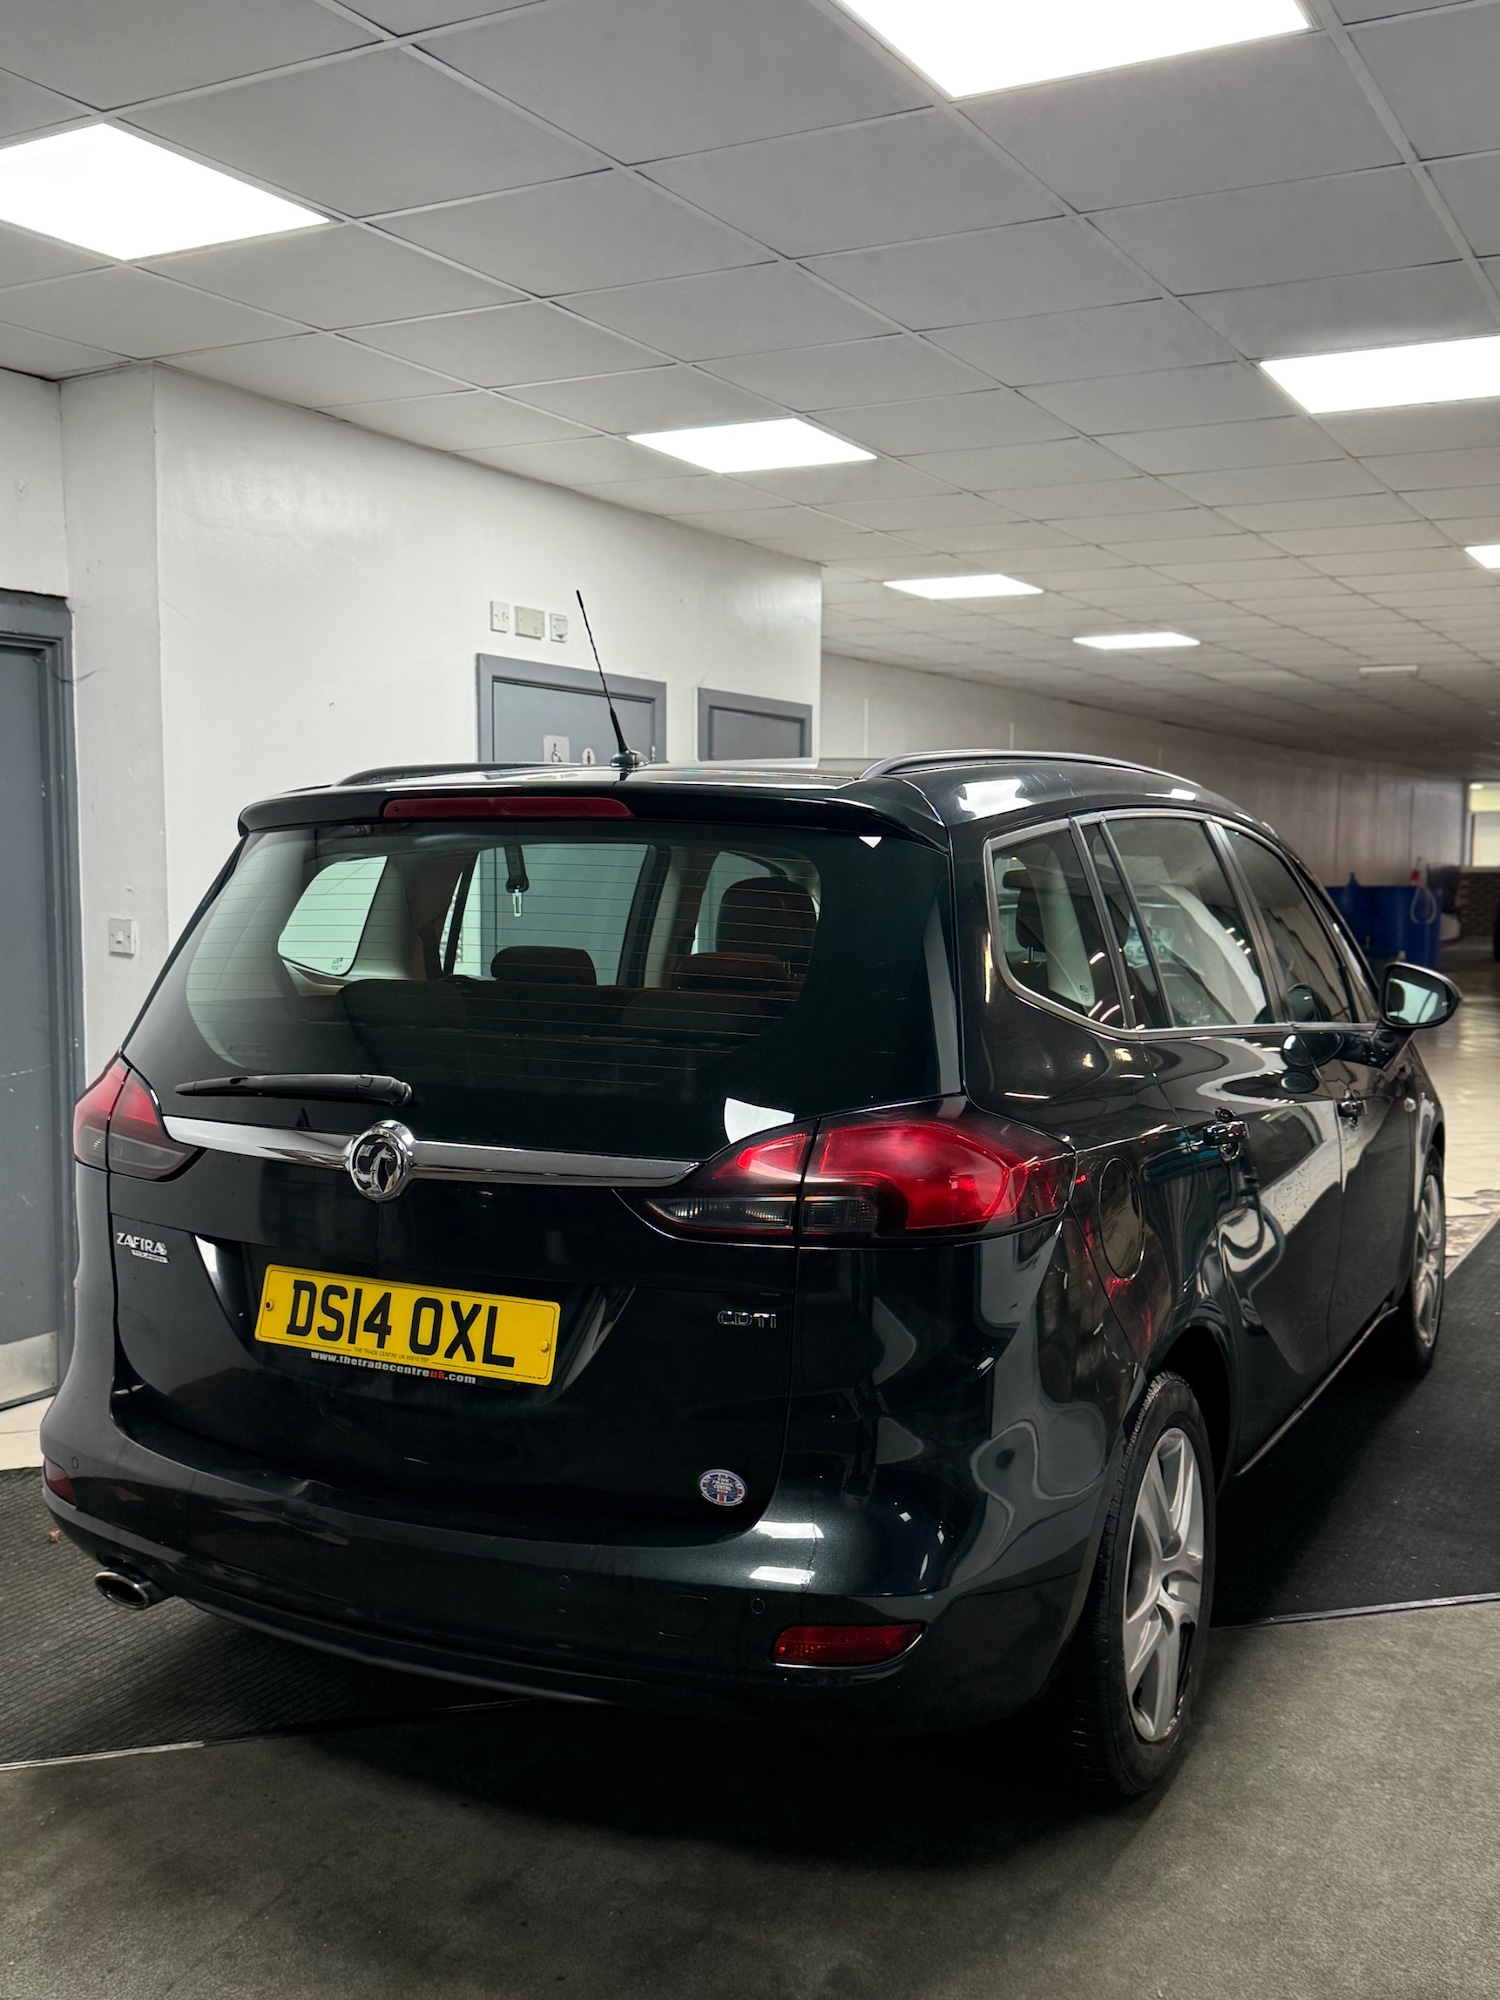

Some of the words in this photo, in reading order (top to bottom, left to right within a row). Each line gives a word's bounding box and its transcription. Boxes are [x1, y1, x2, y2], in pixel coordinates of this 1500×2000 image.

[116, 1232, 167, 1255] ZAFIRA
[286, 1279, 392, 1349] DS14
[409, 1296, 515, 1368] OXL
[310, 1351, 476, 1384] www.thetradecentreuk.com
